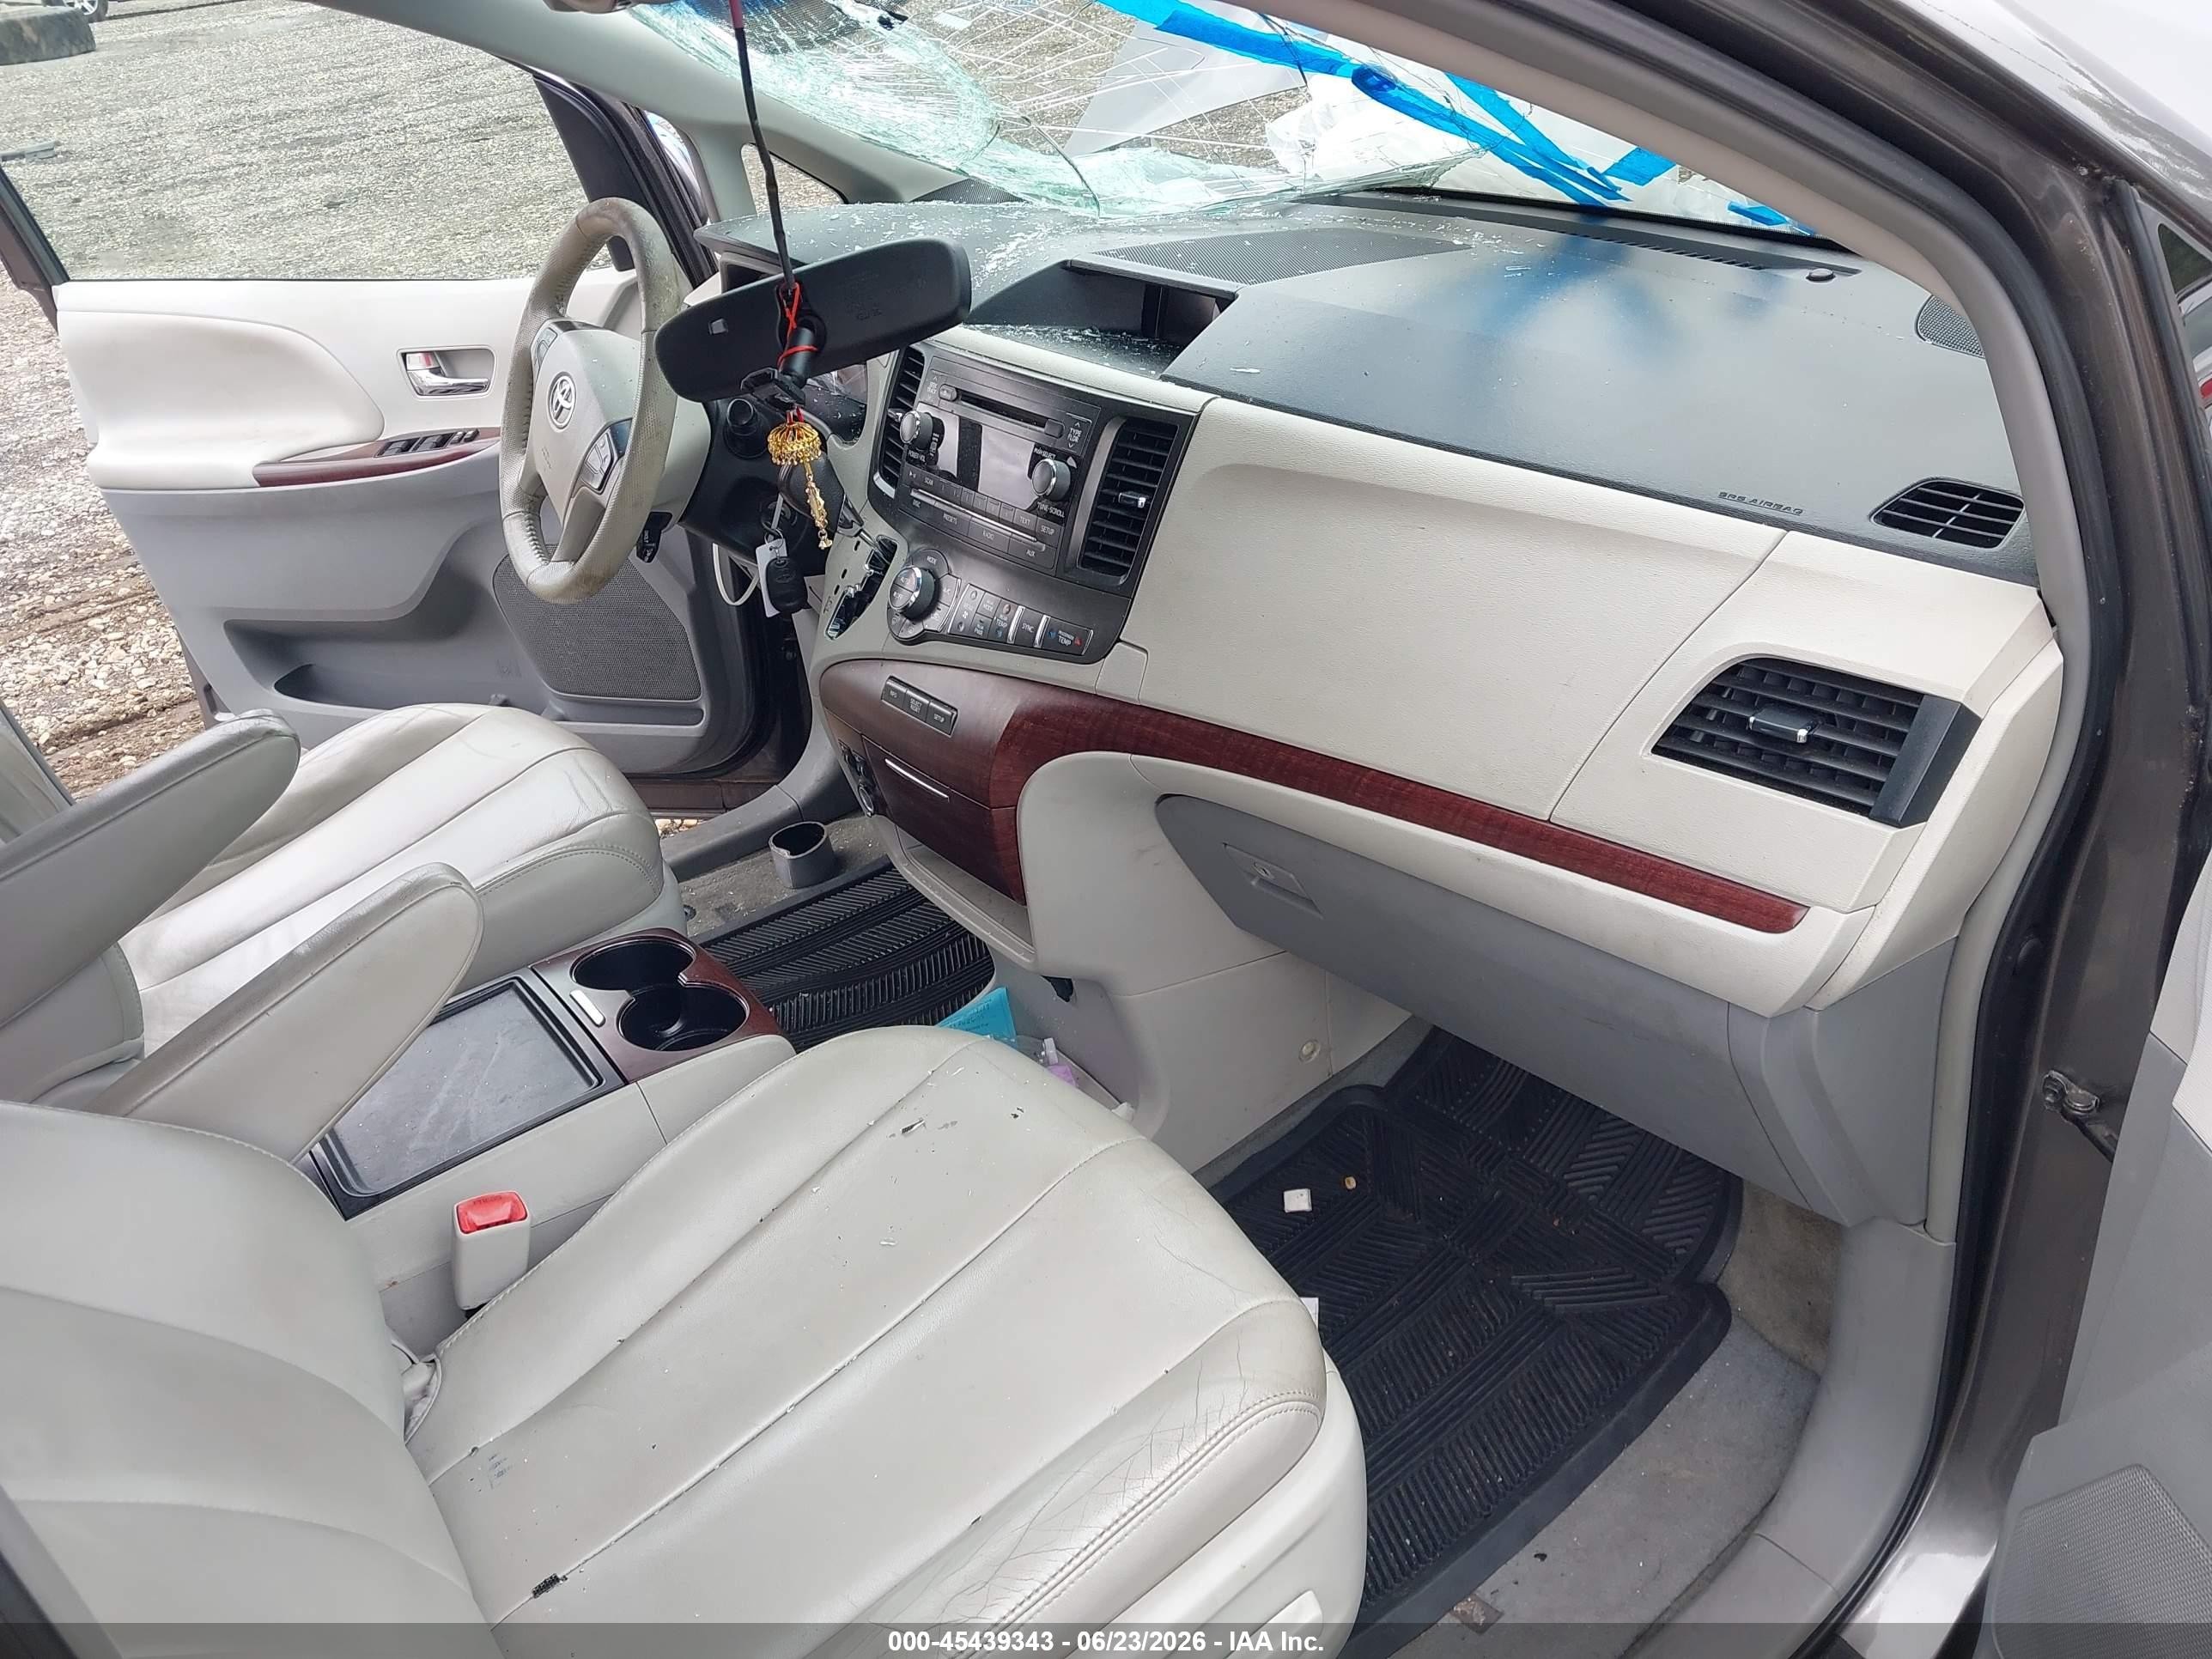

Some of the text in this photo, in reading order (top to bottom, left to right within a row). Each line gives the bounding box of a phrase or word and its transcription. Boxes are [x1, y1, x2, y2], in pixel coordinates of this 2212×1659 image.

[1070, 428, 1082, 437] TYPE
[1718, 491, 1803, 514] SRS AIRBAG
[1019, 516, 1030, 526] TEXT
[1041, 525, 1055, 535] SETUP
[1026, 549, 1036, 557] AUX
[996, 618, 1008, 629] TEMP
[1021, 623, 1035, 633] SYNC
[1058, 635, 1072, 646] TEMP
